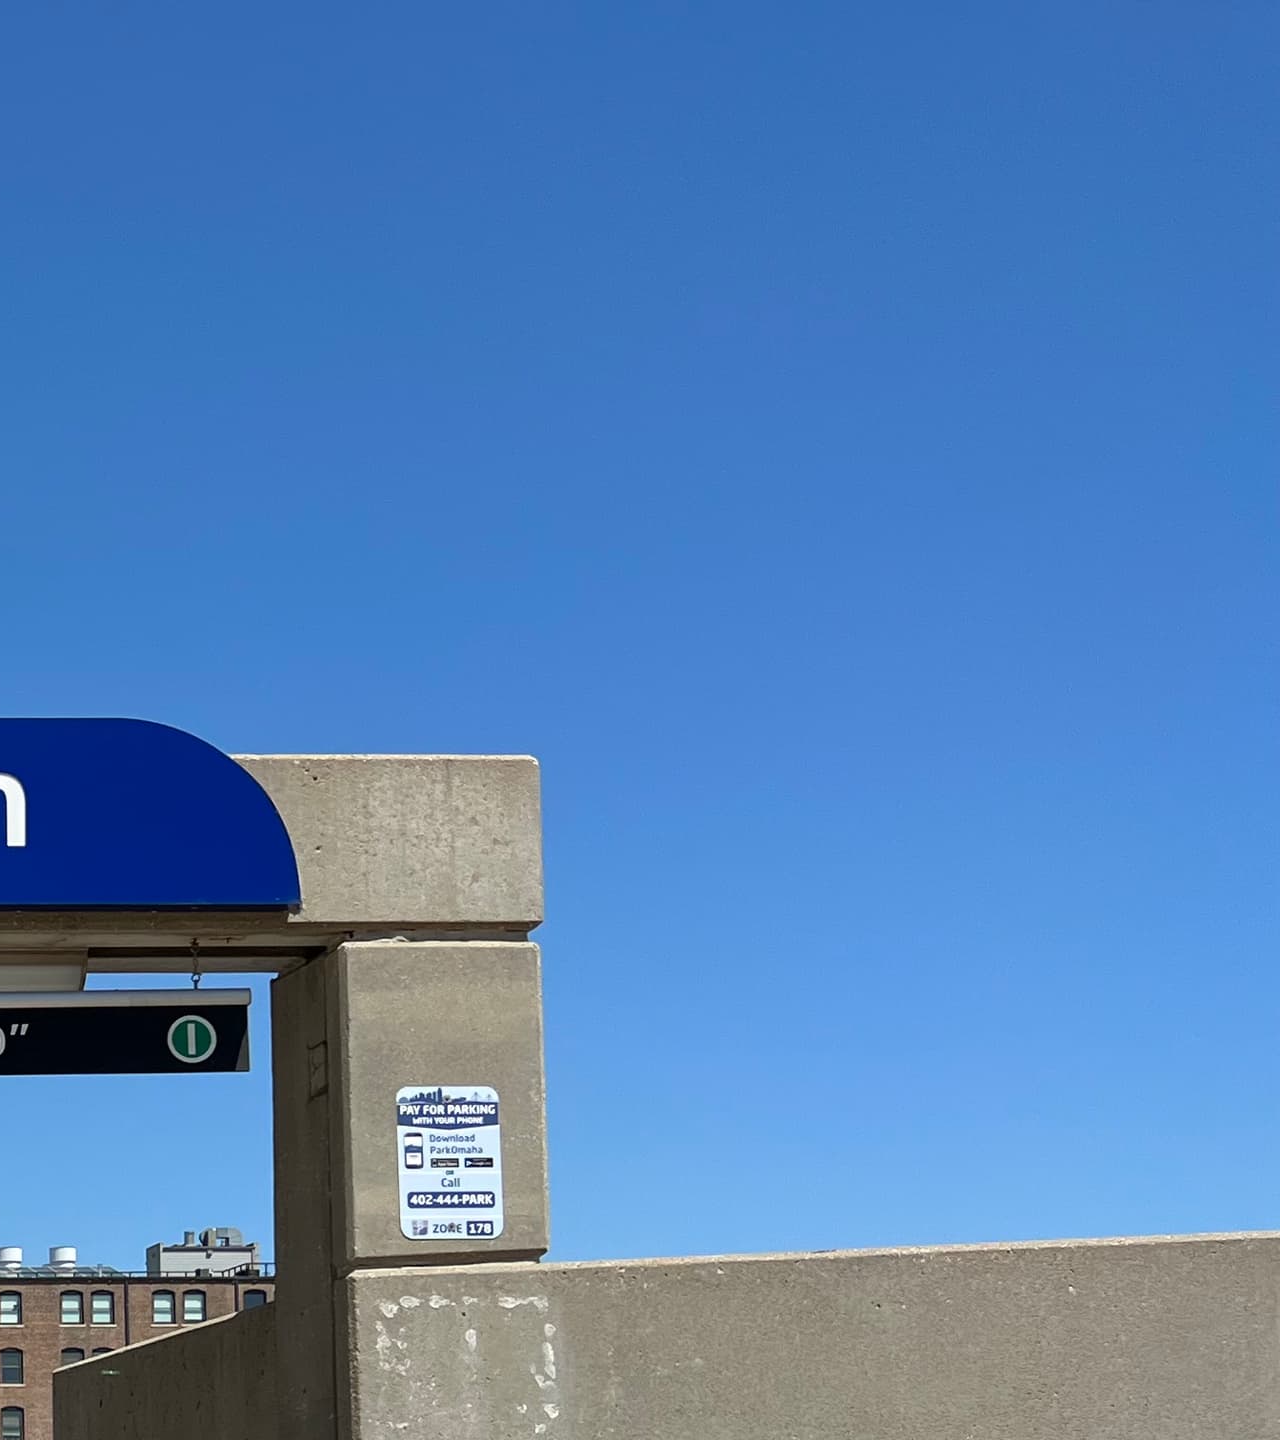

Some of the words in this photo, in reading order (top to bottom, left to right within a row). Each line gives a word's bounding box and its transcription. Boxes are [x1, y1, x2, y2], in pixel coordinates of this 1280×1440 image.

[400, 1105, 420, 1115] PAY
[423, 1105, 444, 1114] FOR
[448, 1104, 496, 1114] PARKING
[429, 1134, 475, 1142] Download
[441, 1178, 460, 1187] Call
[410, 1194, 493, 1205] 402-444-PARK
